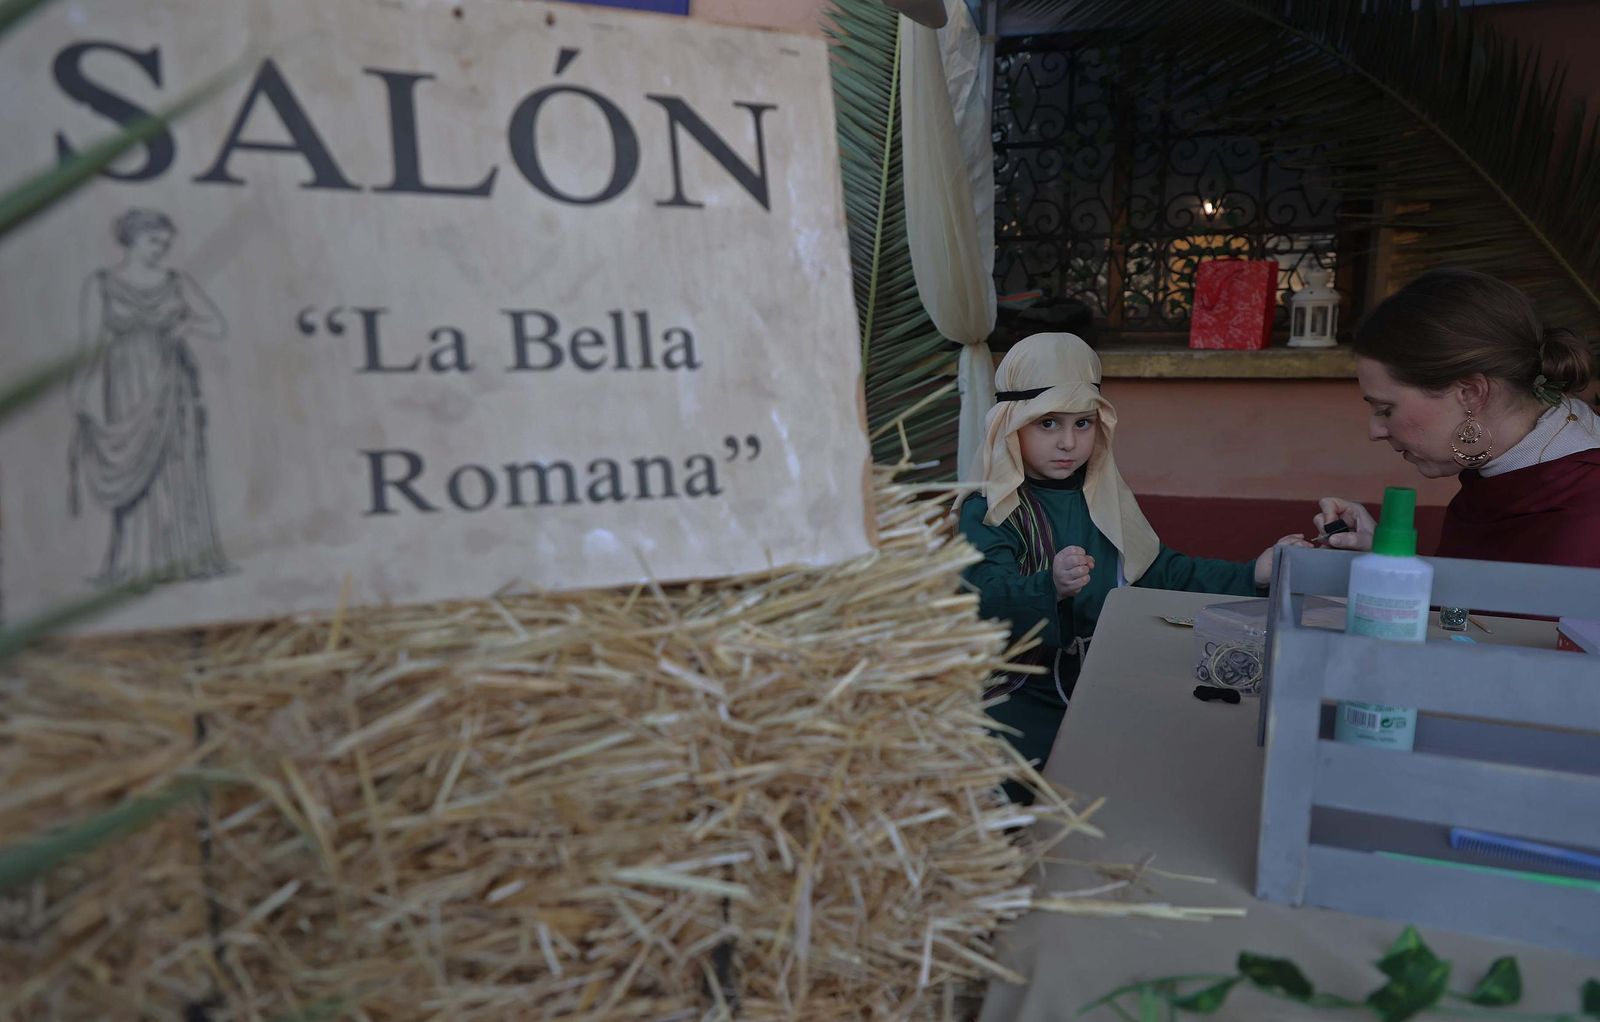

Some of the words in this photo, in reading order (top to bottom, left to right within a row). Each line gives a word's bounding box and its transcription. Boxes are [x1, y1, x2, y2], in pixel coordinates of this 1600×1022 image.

[51, 40, 778, 213] SALÓN
[296, 306, 474, 374] “La
[500, 308, 703, 374] Bella
[359, 436, 763, 517] Romana”
